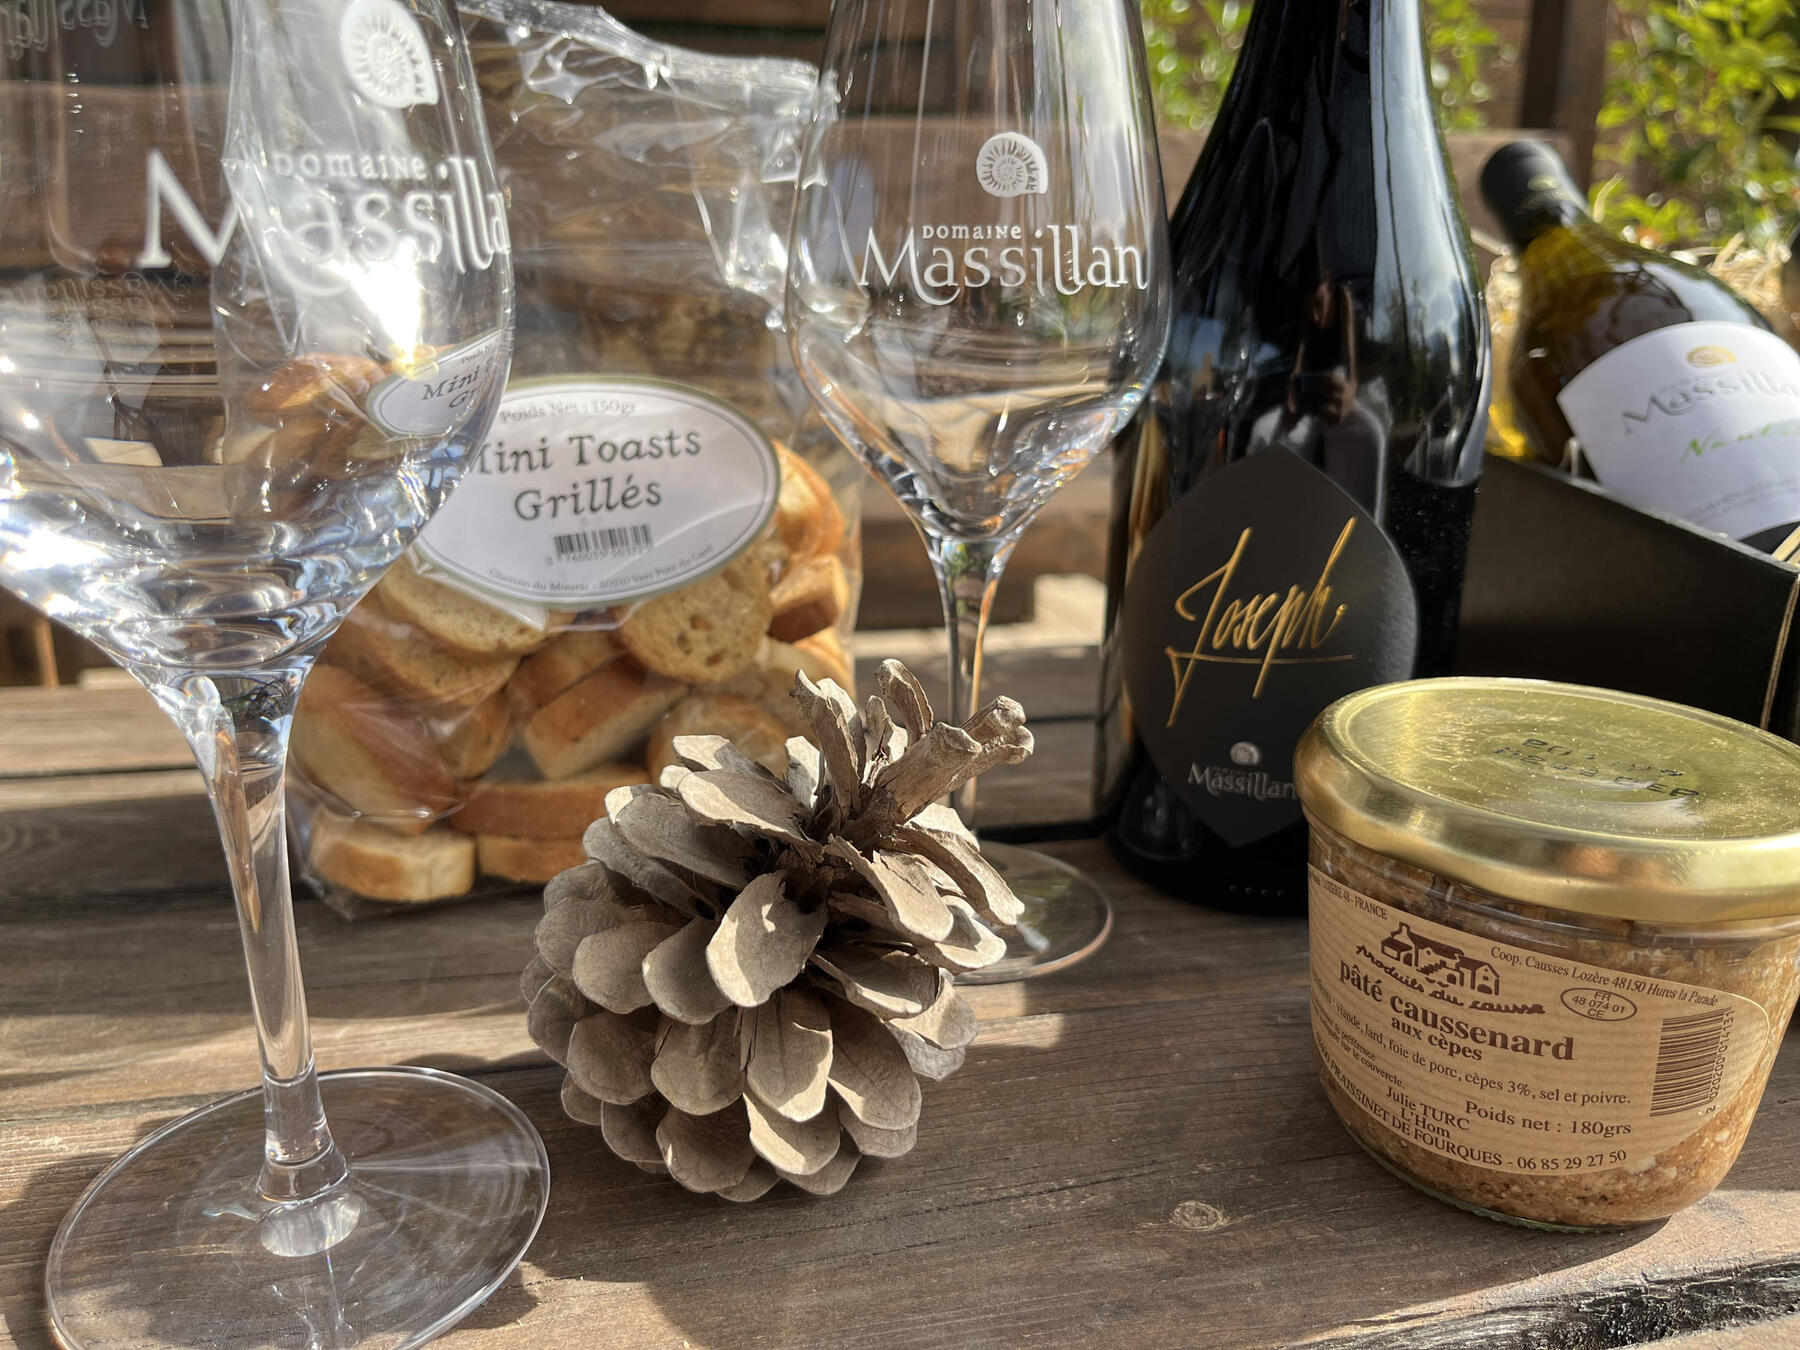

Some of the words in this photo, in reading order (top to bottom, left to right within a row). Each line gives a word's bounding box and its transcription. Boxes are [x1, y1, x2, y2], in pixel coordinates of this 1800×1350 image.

[135, 150, 511, 297] Massilla
[858, 225, 1148, 306] Massillan
[422, 364, 480, 400] Mini
[568, 430, 701, 466] Toasts
[513, 473, 661, 521] Grillés
[1165, 517, 1357, 728] Joseph
[1187, 762, 1298, 801] Massillan
[1354, 896, 1388, 920] FRANCE
[1490, 945, 1523, 966] Coop.
[1525, 956, 1569, 976] Causses
[1571, 967, 1610, 985] Lozère
[1612, 976, 1647, 993] 48150
[1646, 983, 1677, 999] Hures
[1677, 988, 1688, 1001] la
[1687, 990, 1719, 1007] Parade
[1593, 991, 1612, 1002] FR
[1339, 959, 1384, 1002] pâté
[1389, 995, 1575, 1061] caussenard
[1571, 995, 1587, 1005] 48
[1588, 999, 1610, 1010] 074
[1611, 1004, 1625, 1014] 01
[1587, 1008, 1607, 1018] CE
[1391, 1016, 1423, 1041] aux
[1427, 1031, 1483, 1061] cèpes
[1360, 1056, 1406, 1090] couvercle.
[1365, 1024, 1387, 1049] lard,
[1388, 1037, 1410, 1059] foie
[1411, 1051, 1427, 1067] de
[1429, 1060, 1463, 1082] porc,
[1464, 1072, 1504, 1091] cèpes
[1506, 1080, 1537, 1100] 3%,
[1539, 1088, 1560, 1101] sel
[1564, 1091, 1577, 1103] et
[1581, 1091, 1631, 1106] poivre.
[1330, 1059, 1391, 1121] FRAISSINET
[1391, 1116, 1412, 1136] DE
[1414, 1127, 1504, 1166] FOURQUES
[1516, 1156, 1537, 1170] 06
[1540, 1157, 1560, 1170] 85
[1563, 1156, 1582, 1169] 29
[1586, 1153, 1604, 1168] 27
[1608, 1149, 1627, 1164] 50
[1385, 1085, 1417, 1111] Julie
[1419, 1102, 1471, 1131] TURC
[1400, 1107, 1451, 1138] L'Hom
[1464, 1099, 1516, 1126] Poids
[1521, 1116, 1551, 1132] net
[1570, 1119, 1632, 1138] 180grs
